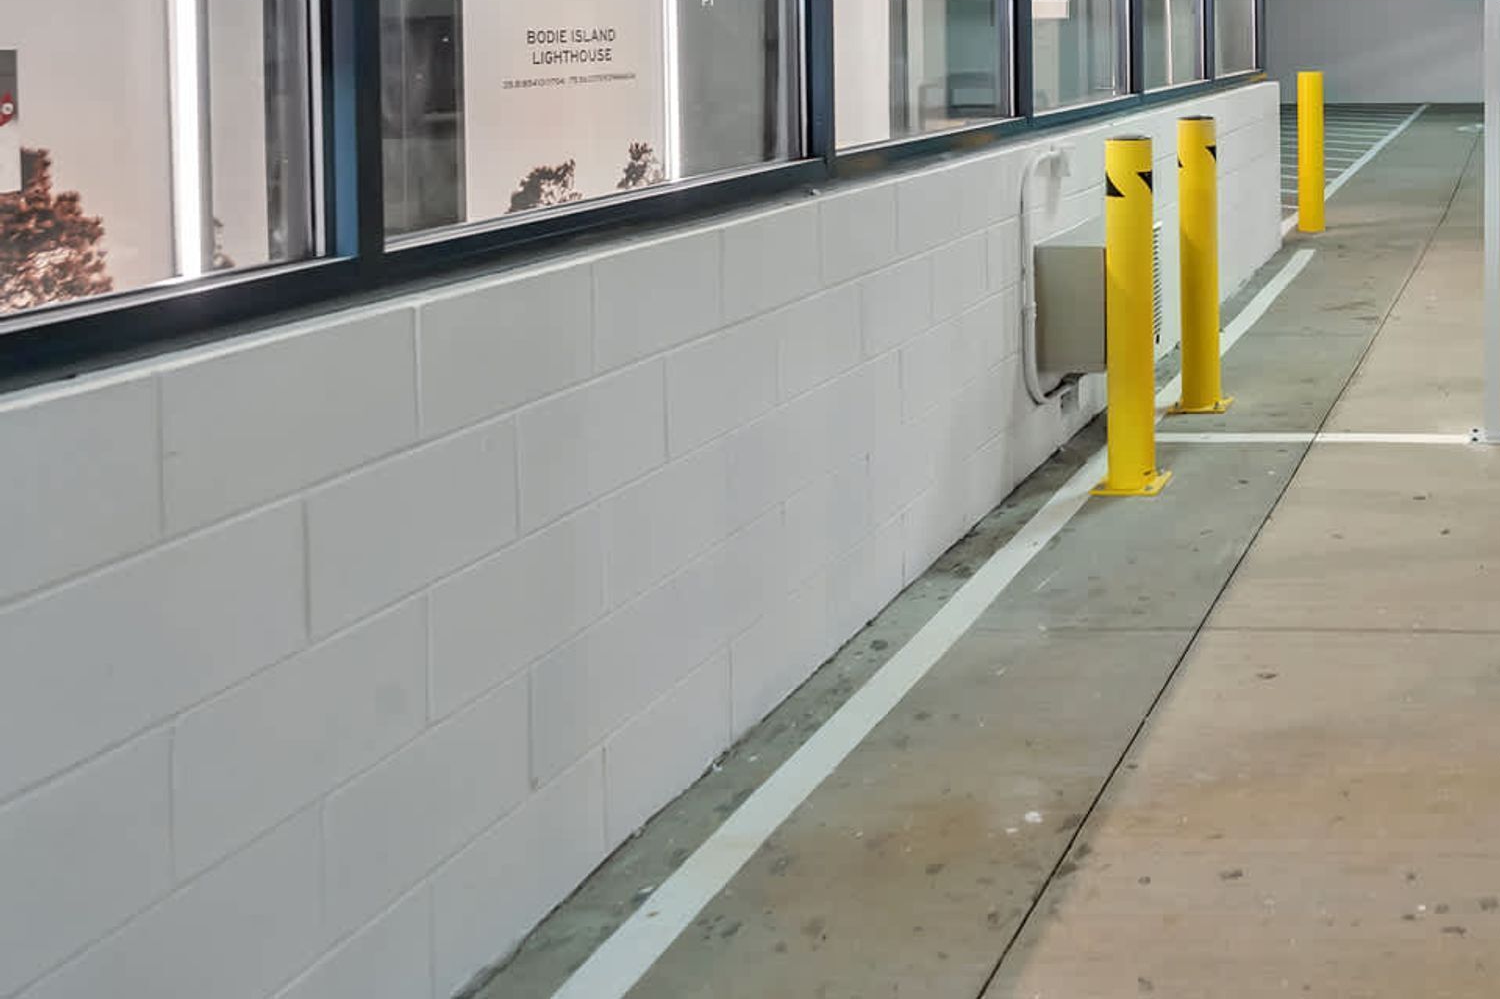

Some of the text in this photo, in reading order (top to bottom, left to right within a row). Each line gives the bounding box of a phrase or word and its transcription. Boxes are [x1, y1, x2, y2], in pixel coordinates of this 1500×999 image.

[526, 28, 616, 44] BODIE ISLAND
[532, 48, 612, 65] LIGHTHOUSE
